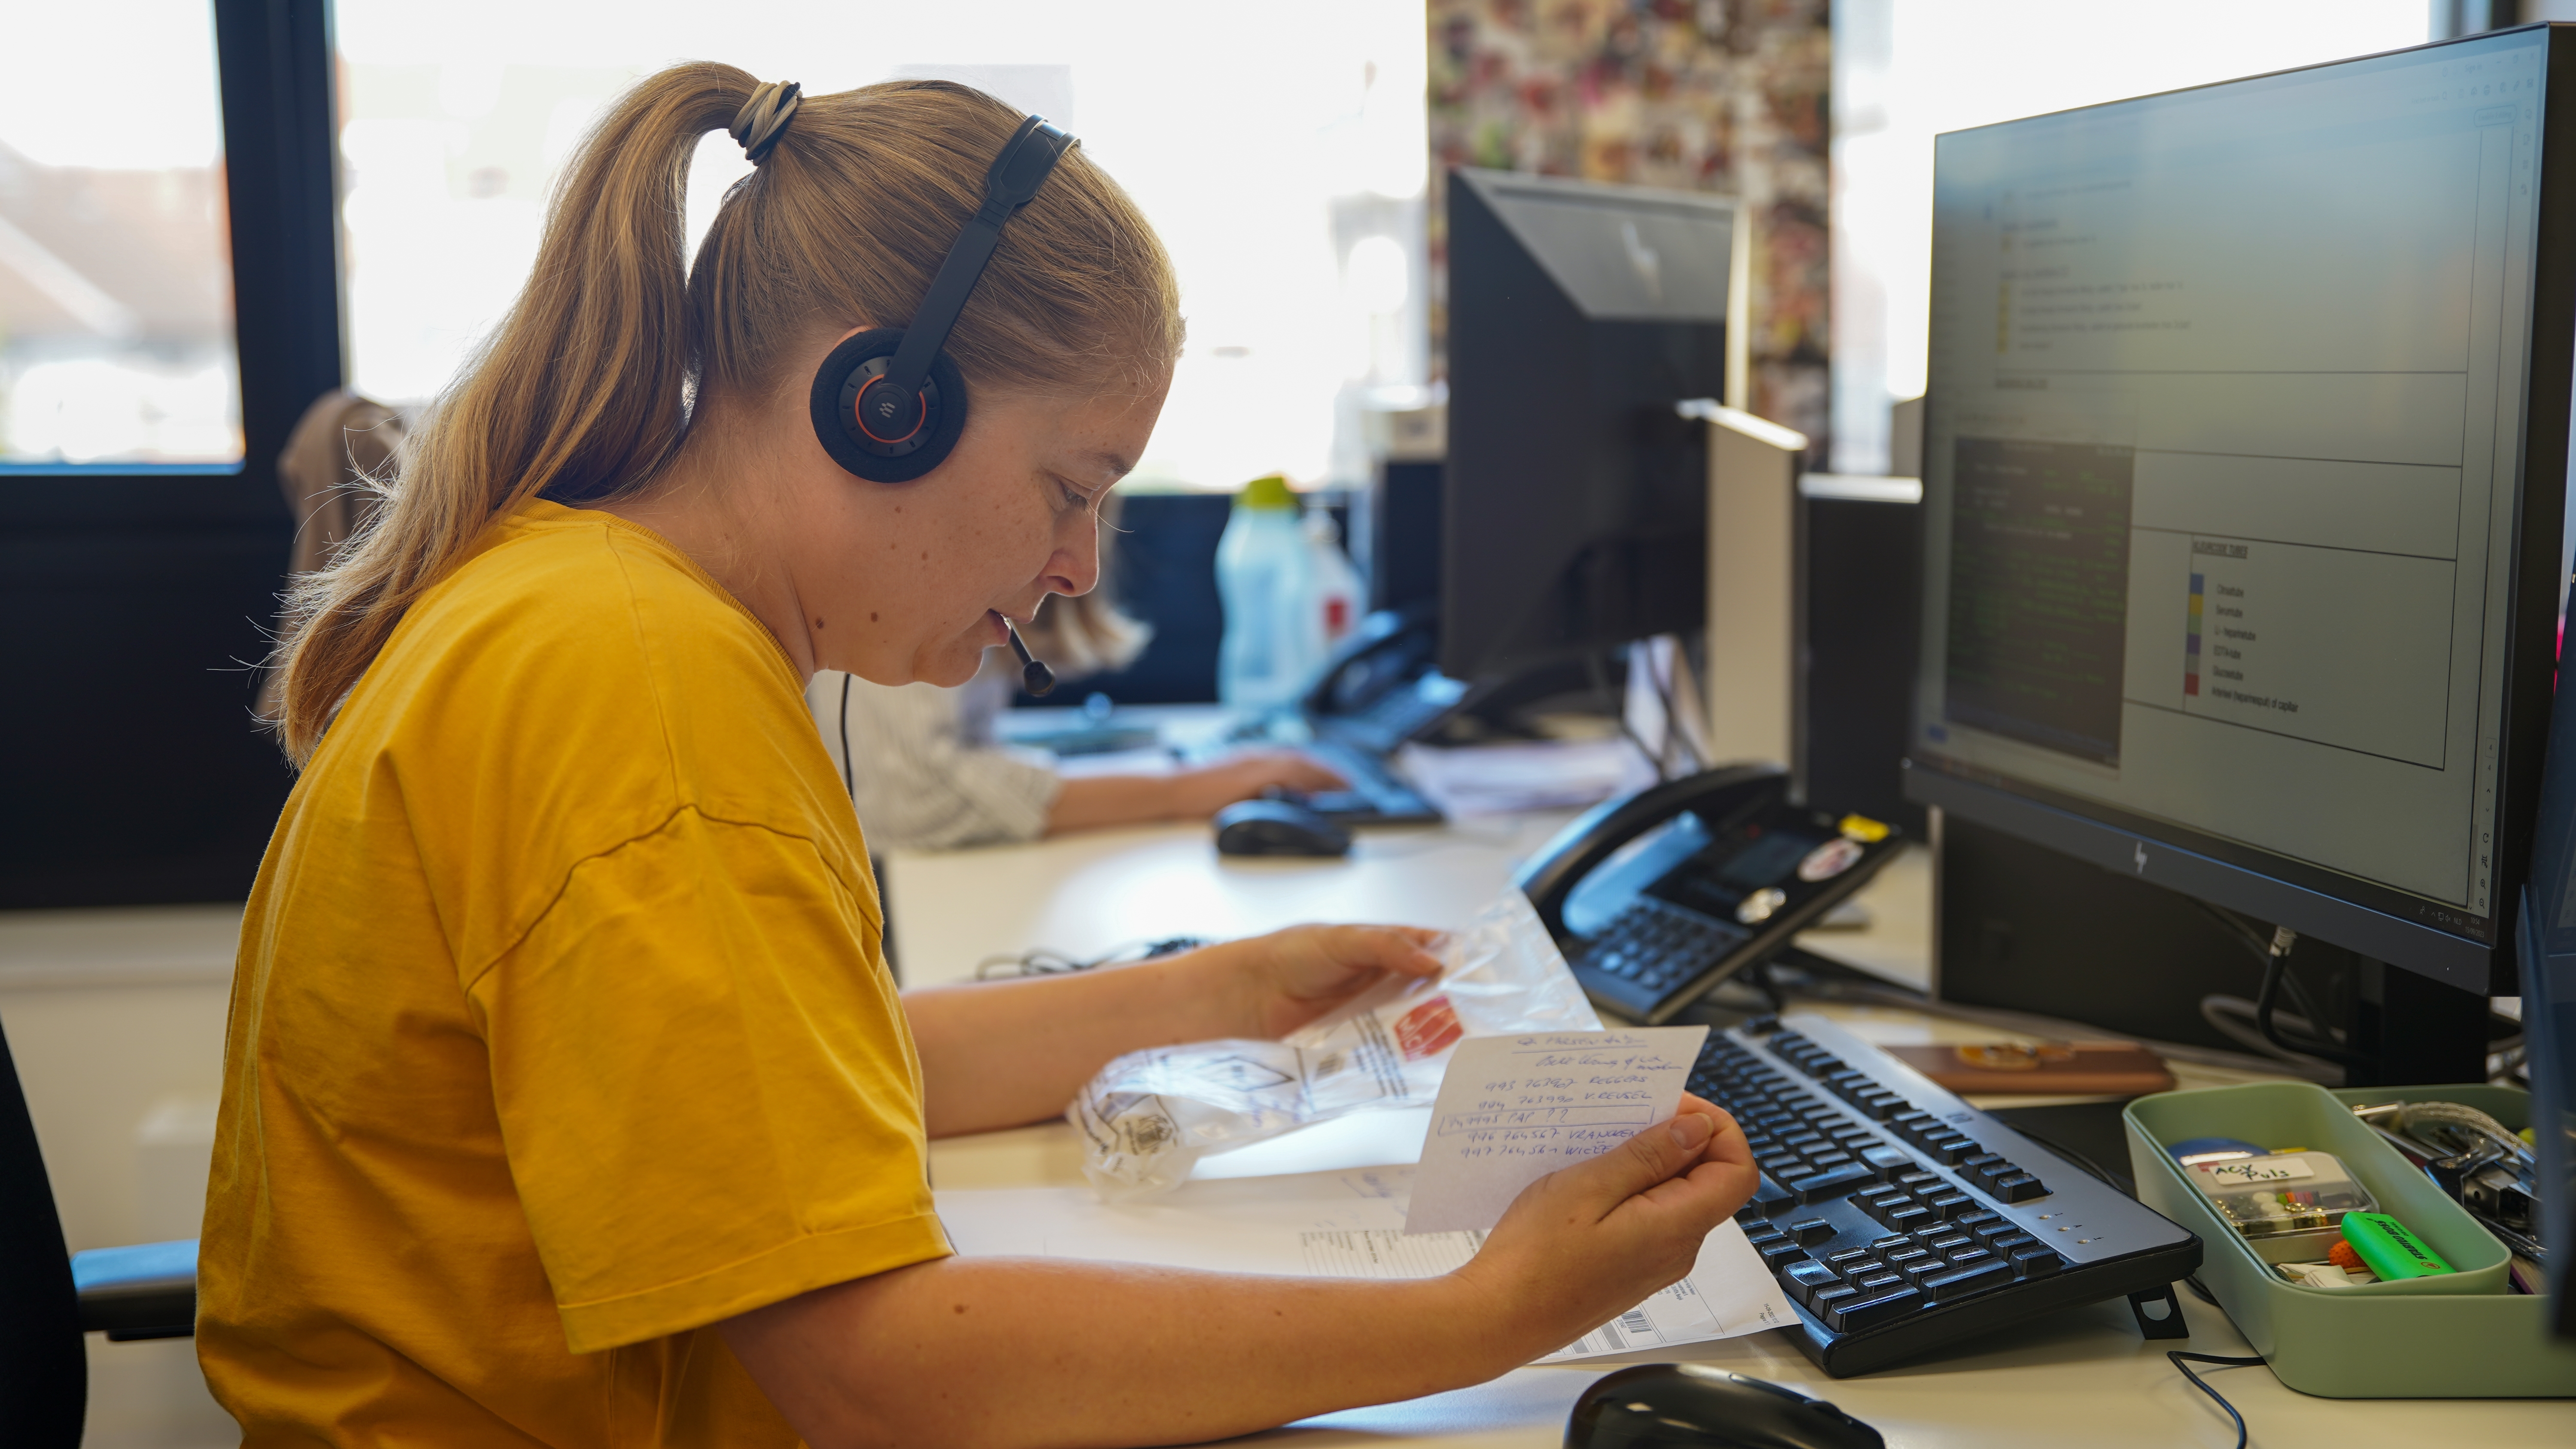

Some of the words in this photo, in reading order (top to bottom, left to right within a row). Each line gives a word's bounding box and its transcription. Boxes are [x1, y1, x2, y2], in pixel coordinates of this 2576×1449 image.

[2465, 65, 2476, 74] Sign
[2471, 917, 2480, 925] 10:54
[2466, 926, 2484, 937] 15/09/2023
[2374, 1220, 2398, 1238] BOSS
[2390, 1222, 2409, 1237] ORIGINAL
[2393, 1235, 2428, 1260] STABILO
[1764, 1303, 1776, 1318] 15-09-2023
[1759, 1313, 1767, 1322] Pagina
